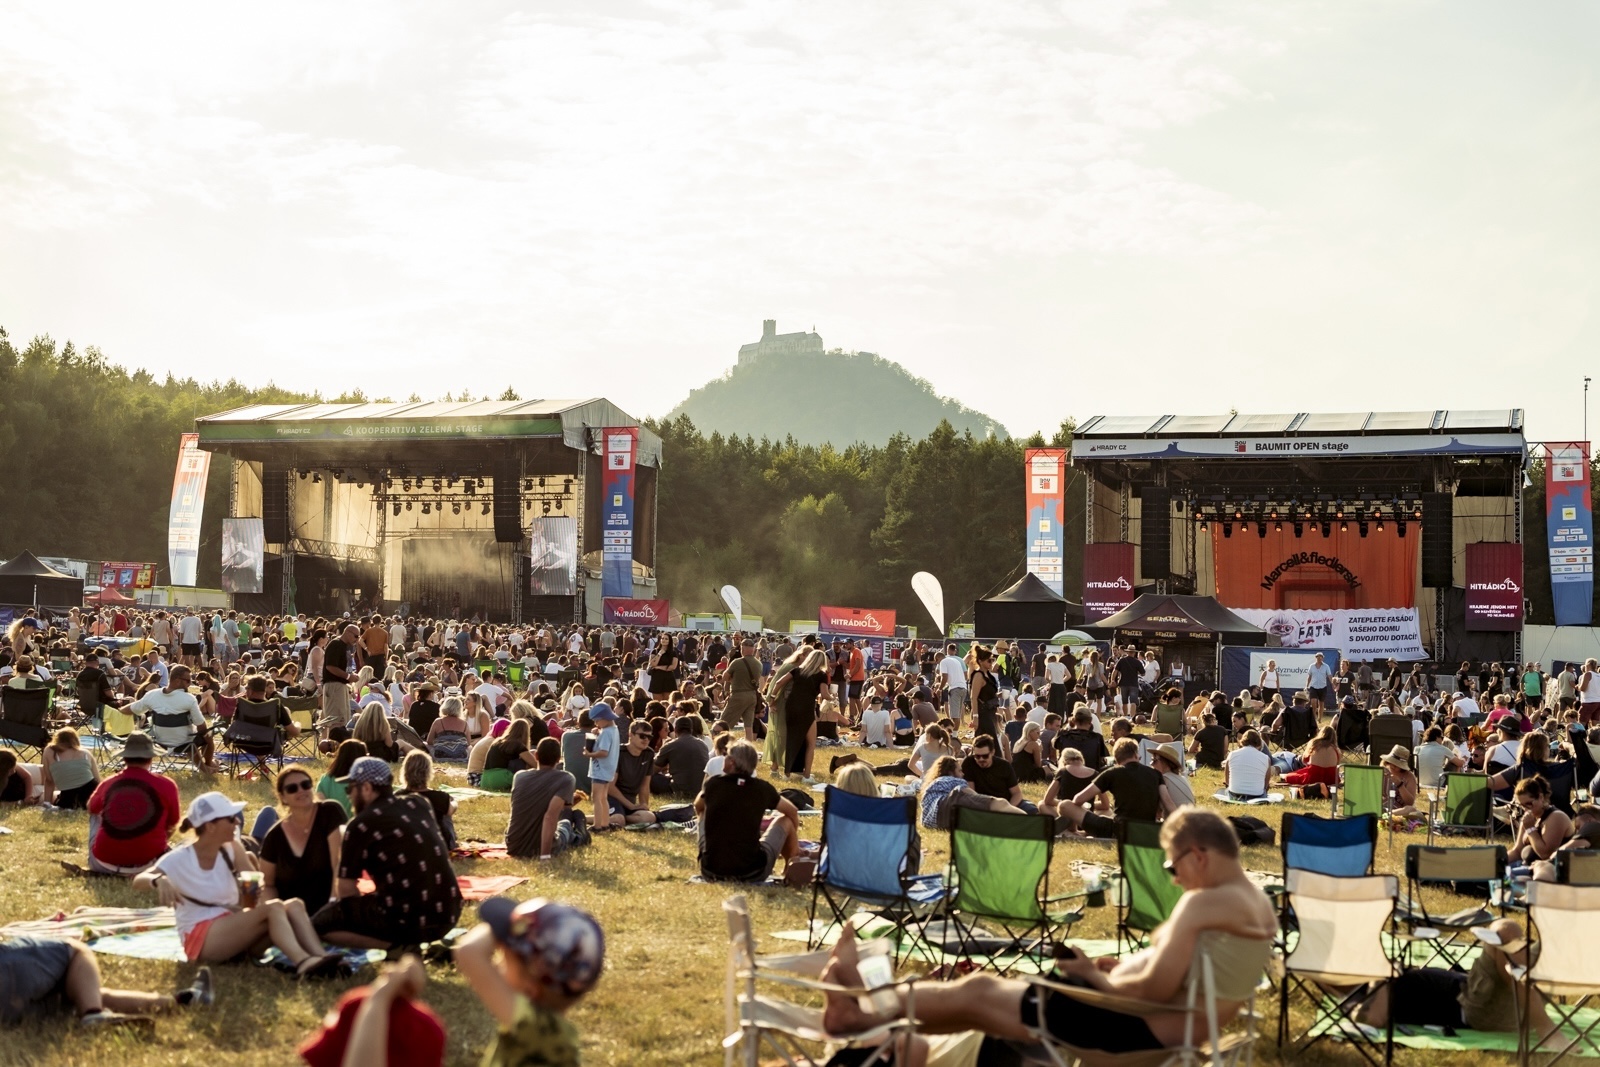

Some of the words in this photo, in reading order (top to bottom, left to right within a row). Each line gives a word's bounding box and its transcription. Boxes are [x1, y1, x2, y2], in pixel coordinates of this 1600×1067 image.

[355, 426, 416, 434] KOOPERATIVA
[419, 424, 452, 434] ZELENÁ
[455, 424, 483, 433] STAGE
[1255, 442, 1291, 451] BAUMIT
[1293, 442, 1320, 451] OPEN
[1321, 442, 1349, 452] stage
[1086, 581, 1120, 589] HITRÁDIO
[1470, 582, 1506, 590] HITRÁDIO
[613, 610, 646, 618] HITRÁDIO
[830, 618, 868, 627] HITRÁDIO
[1348, 616, 1386, 624] ZATEPLETE
[1387, 614, 1414, 623] FASÁDU
[1298, 623, 1333, 639] FAJN
[1348, 625, 1378, 633] VAŠEHO
[1355, 634, 1390, 642] DVOJITOU
[1390, 632, 1418, 641] DOTACÍ!
